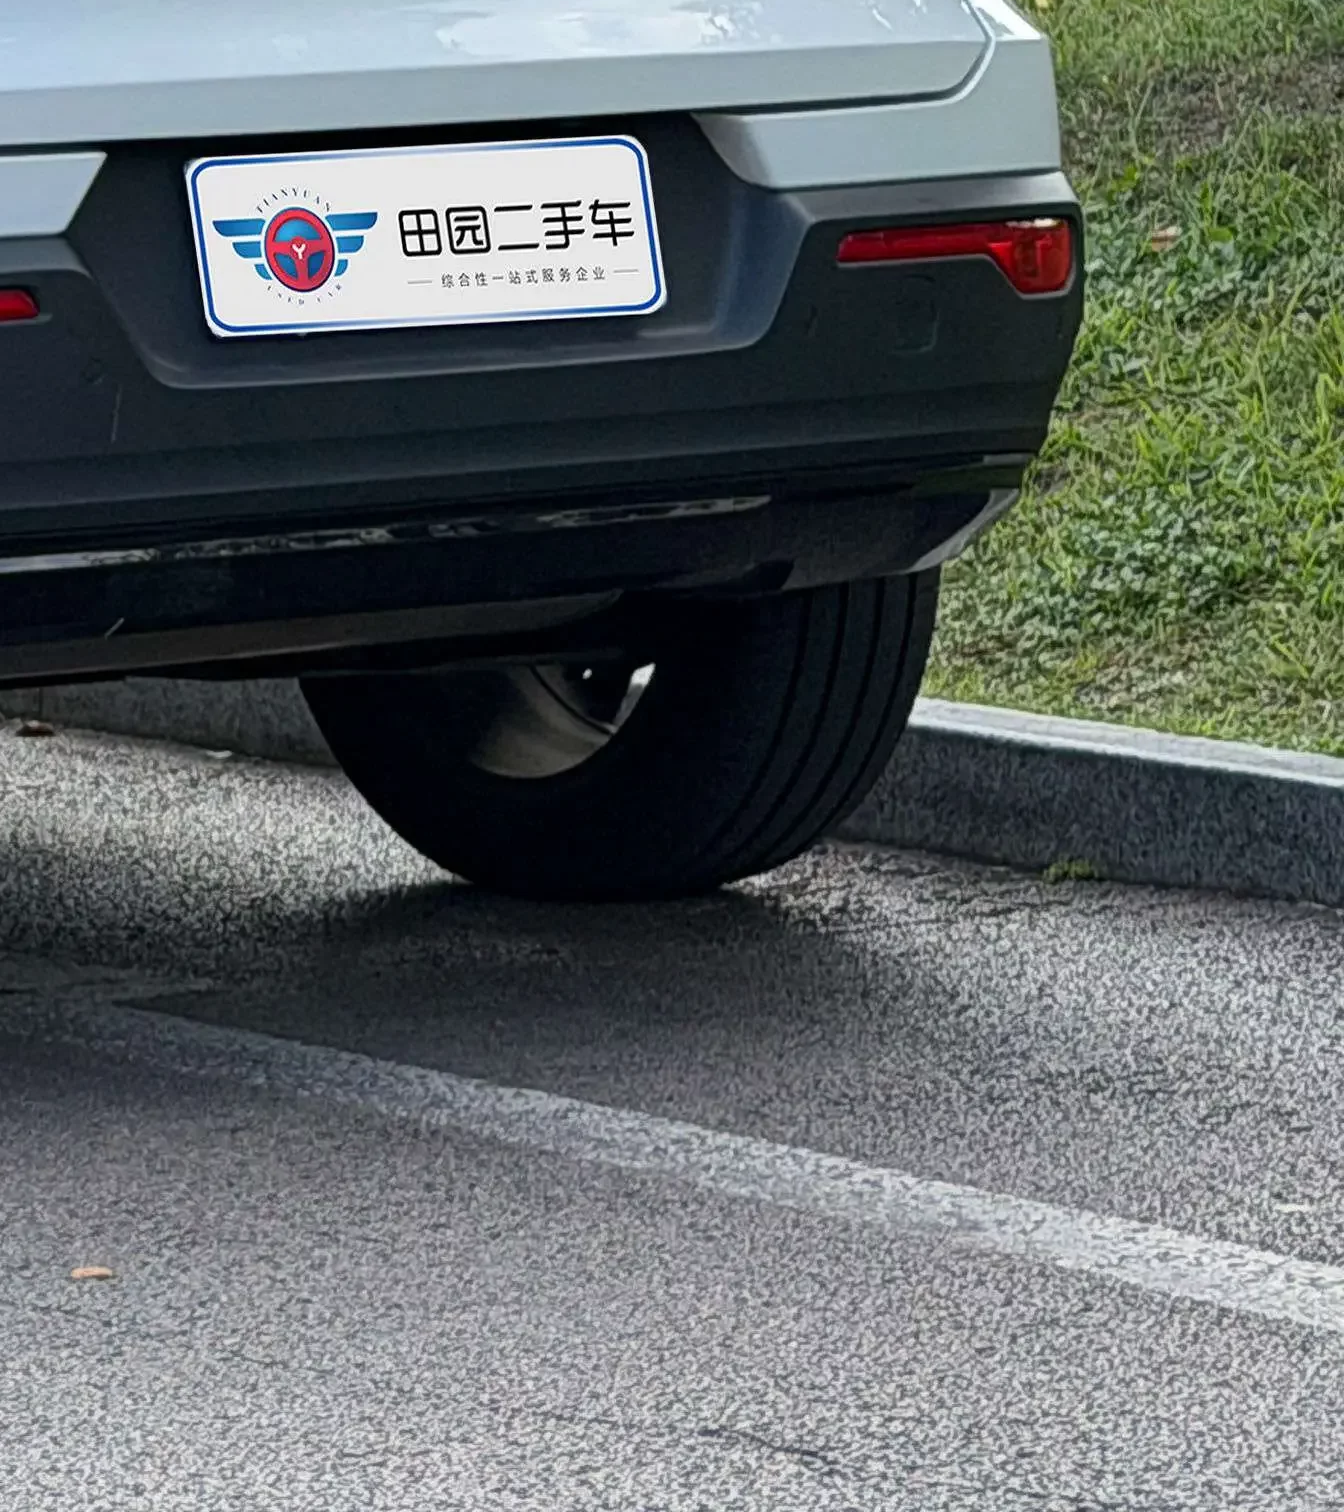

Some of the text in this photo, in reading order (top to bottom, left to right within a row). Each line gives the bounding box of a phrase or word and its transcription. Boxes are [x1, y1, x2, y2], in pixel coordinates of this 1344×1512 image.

[398, 199, 635, 258] 田园二手车
[440, 265, 606, 289] 综合性一站式服务企业
